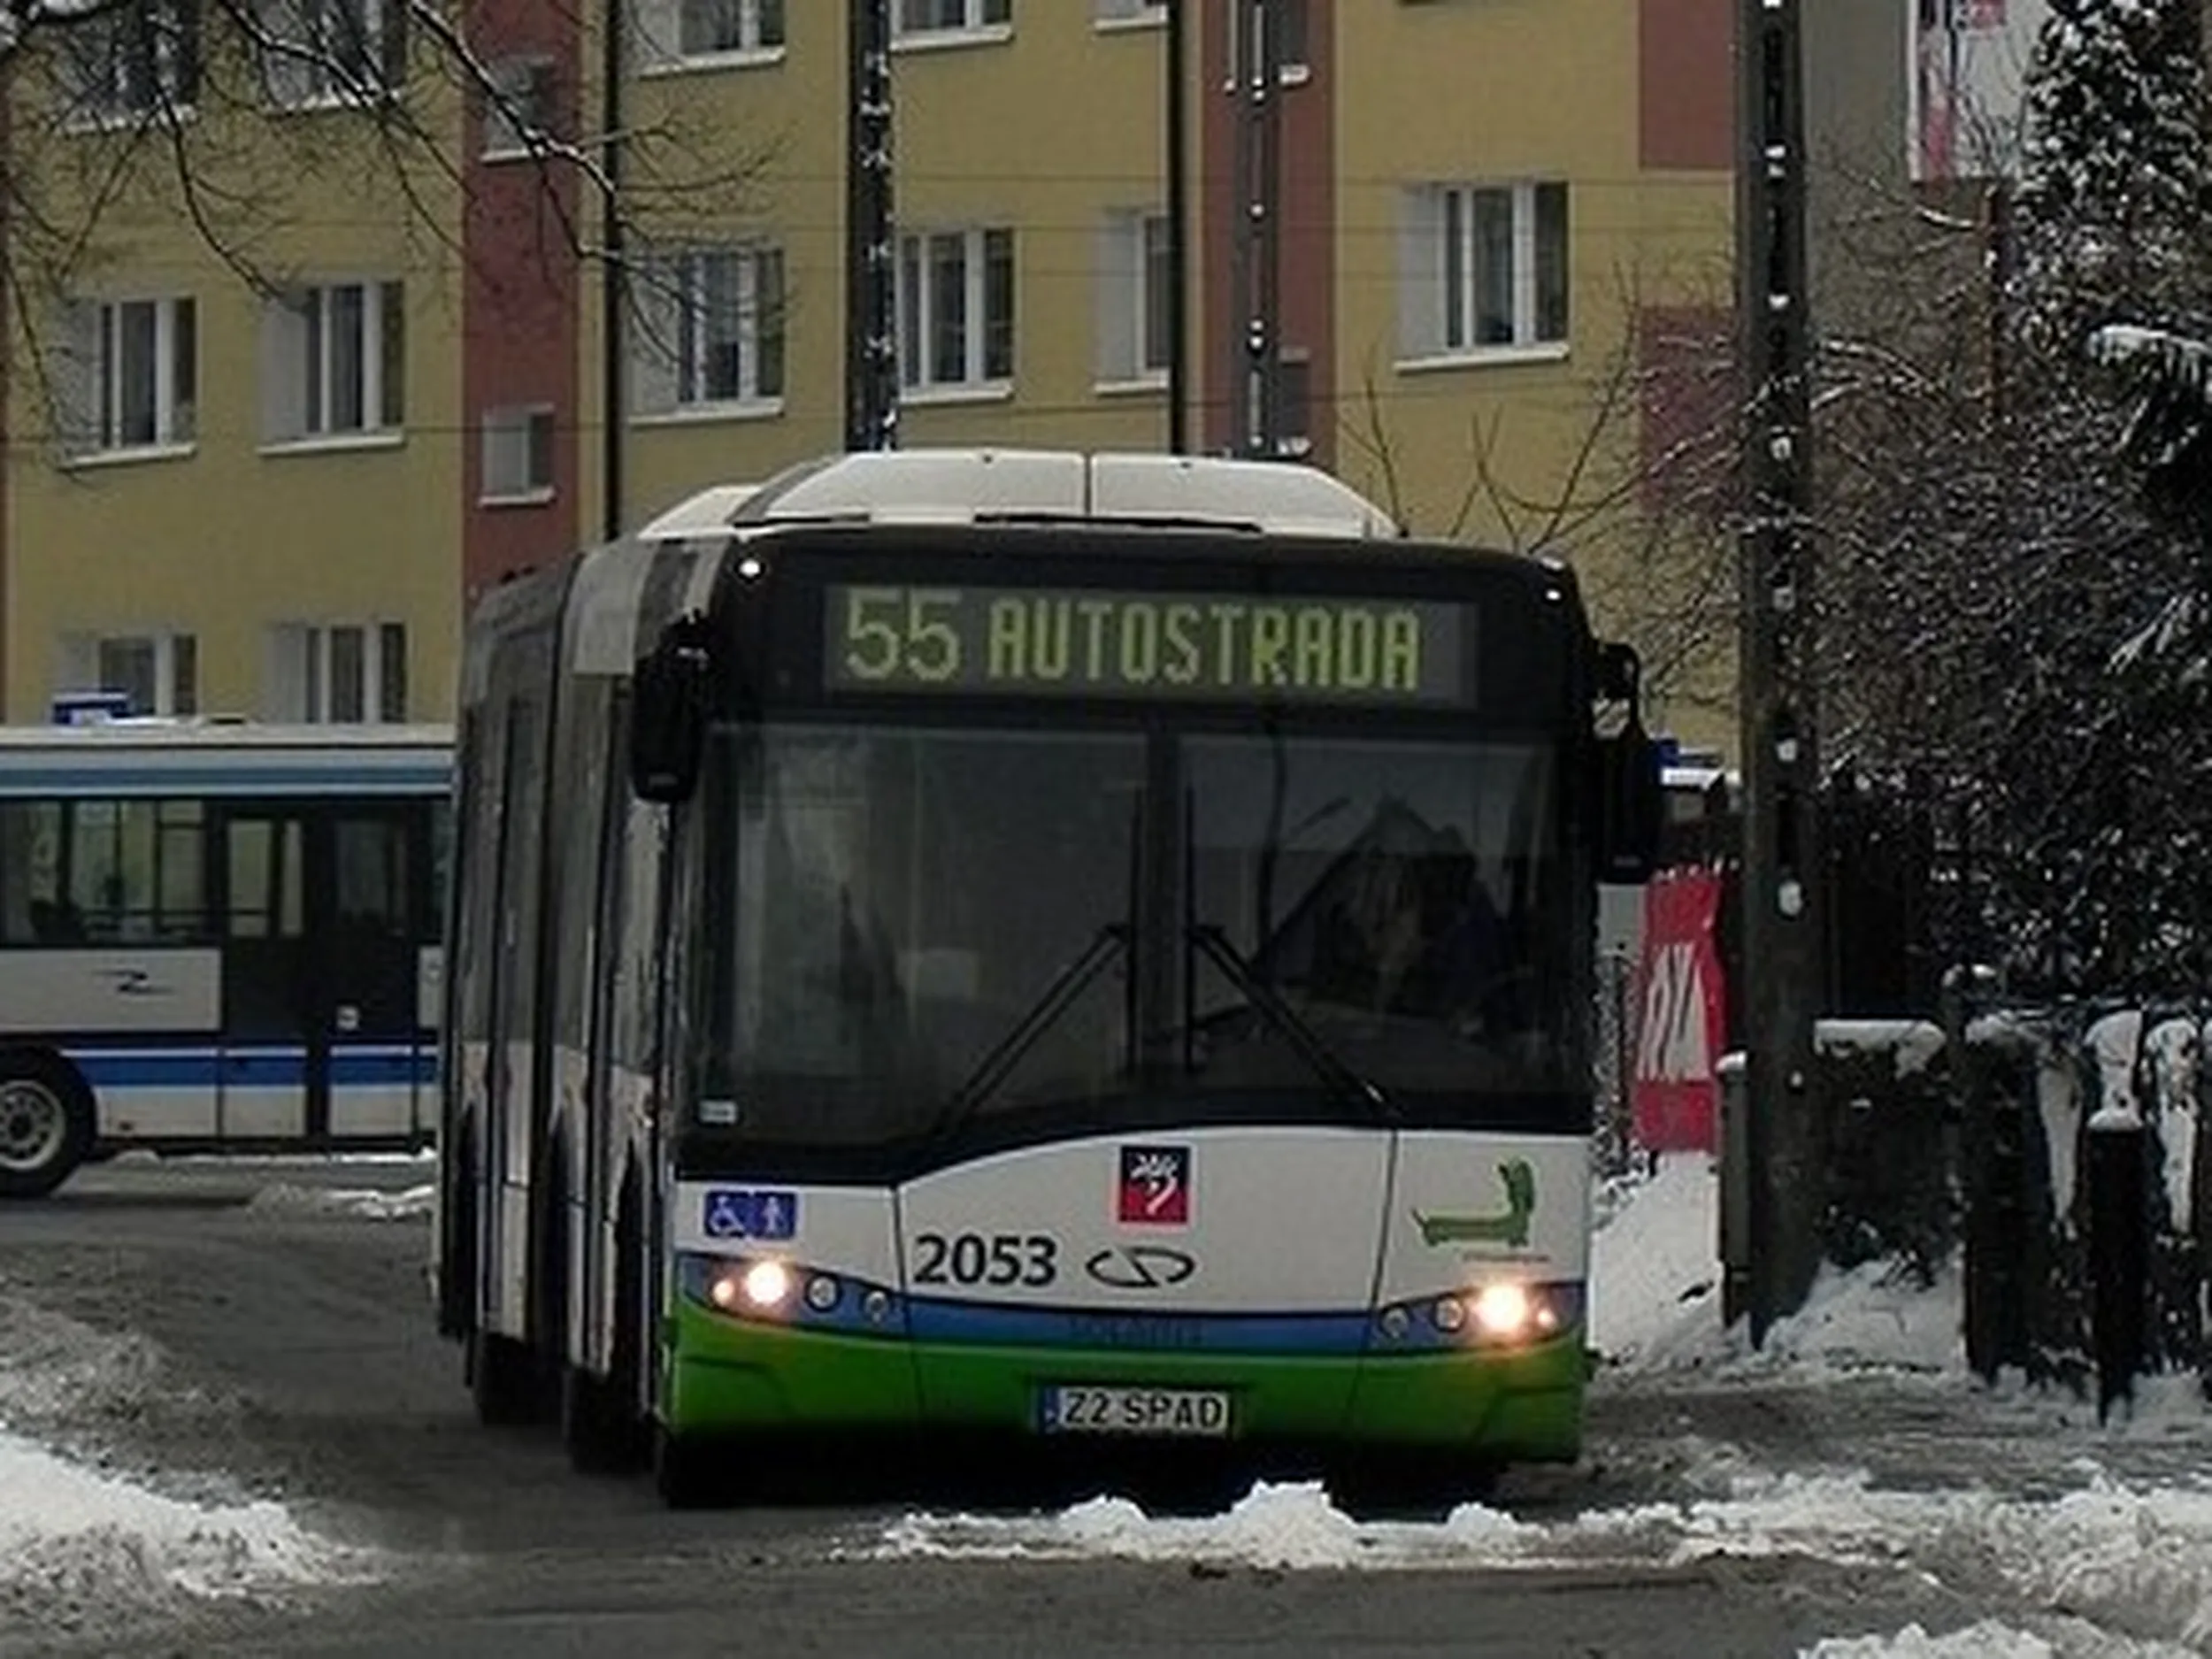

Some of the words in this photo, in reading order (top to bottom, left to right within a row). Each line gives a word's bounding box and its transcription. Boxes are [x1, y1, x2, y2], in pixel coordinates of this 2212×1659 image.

[845, 588, 964, 681] 55
[987, 597, 1419, 690] AUTOSTRADA
[912, 1233, 1058, 1286] 2053
